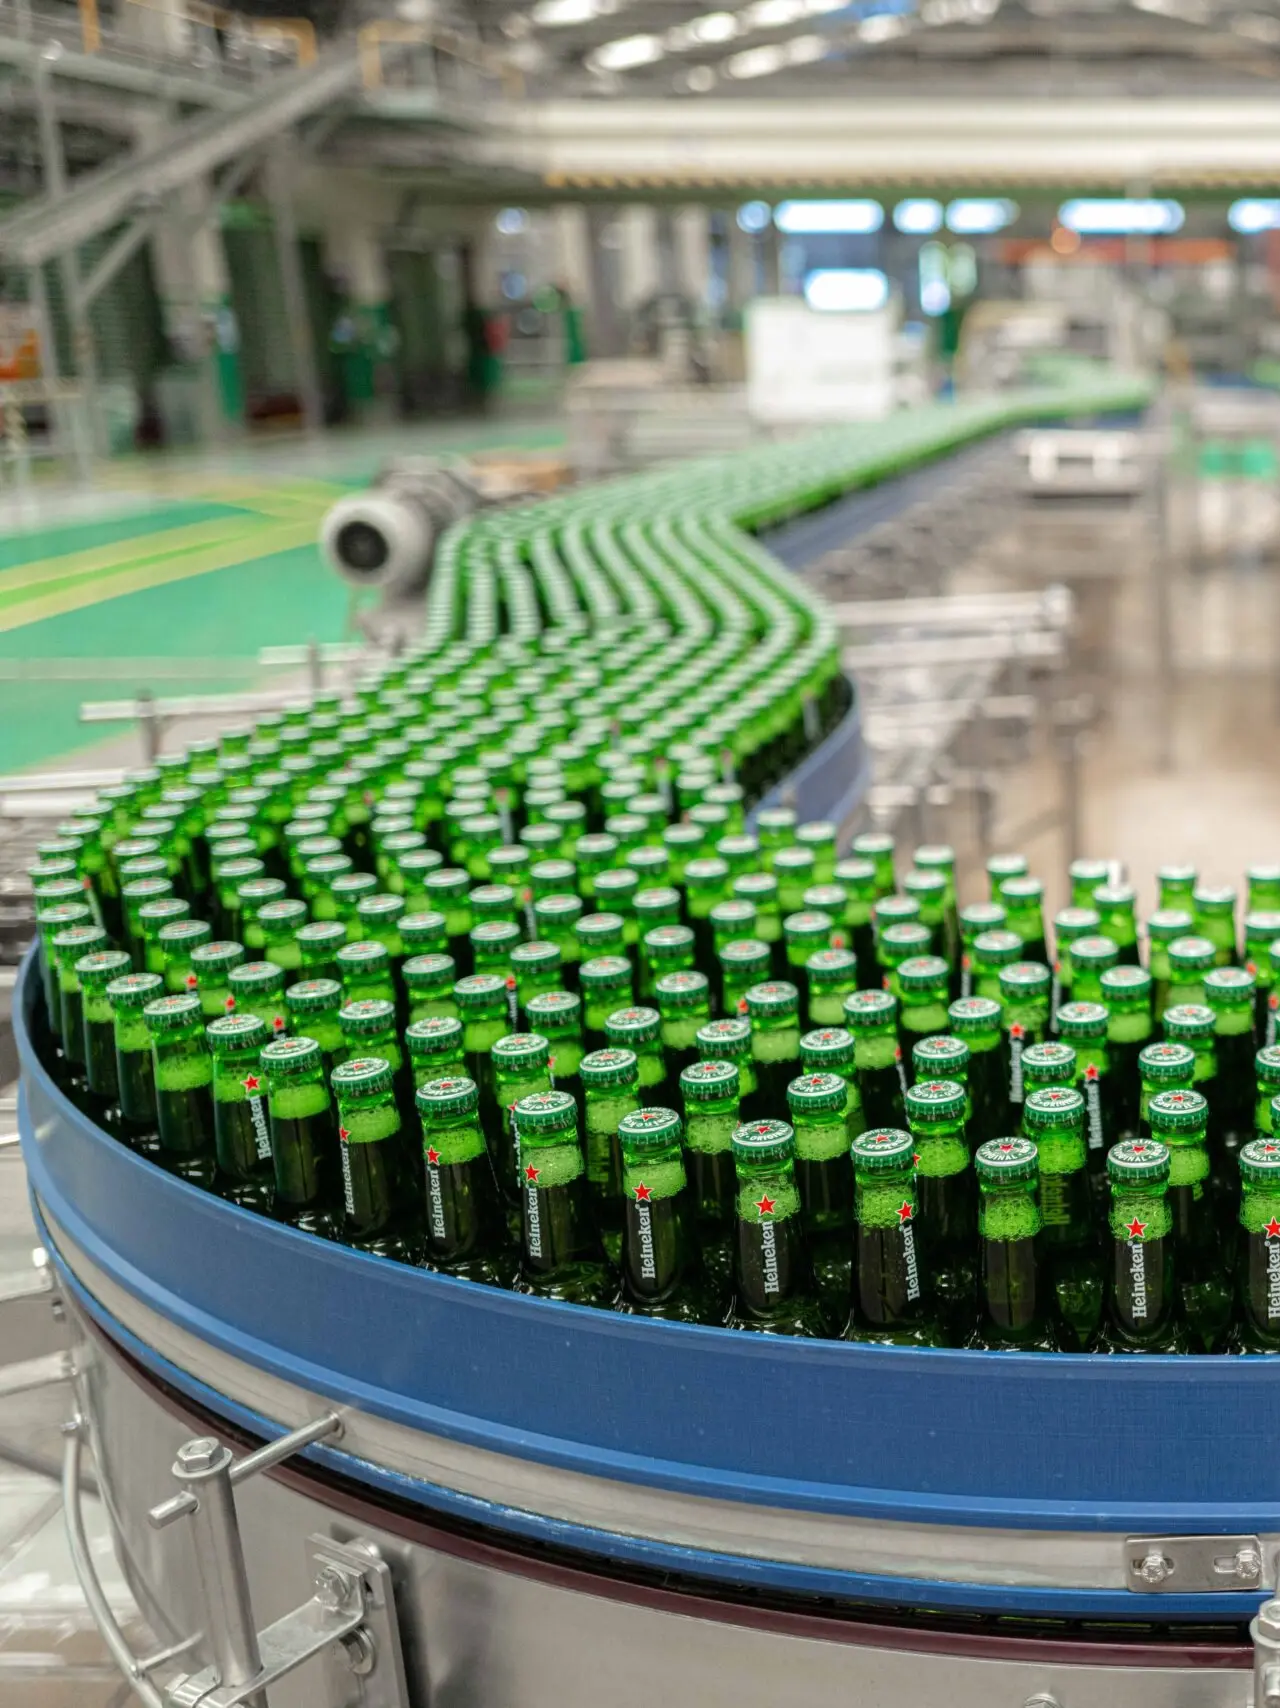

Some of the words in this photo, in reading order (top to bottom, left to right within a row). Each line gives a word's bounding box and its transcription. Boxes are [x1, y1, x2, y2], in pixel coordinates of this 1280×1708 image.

[251, 1096, 272, 1160] Heineken
[340, 1146, 355, 1215] Heineken
[429, 1168, 445, 1239] Heineken
[528, 1188, 542, 1258] Heineken
[637, 1206, 656, 1279] Heineken
[760, 1220, 780, 1294] Heineken
[902, 1224, 921, 1301] Heineken
[1129, 1243, 1147, 1319] Heineken
